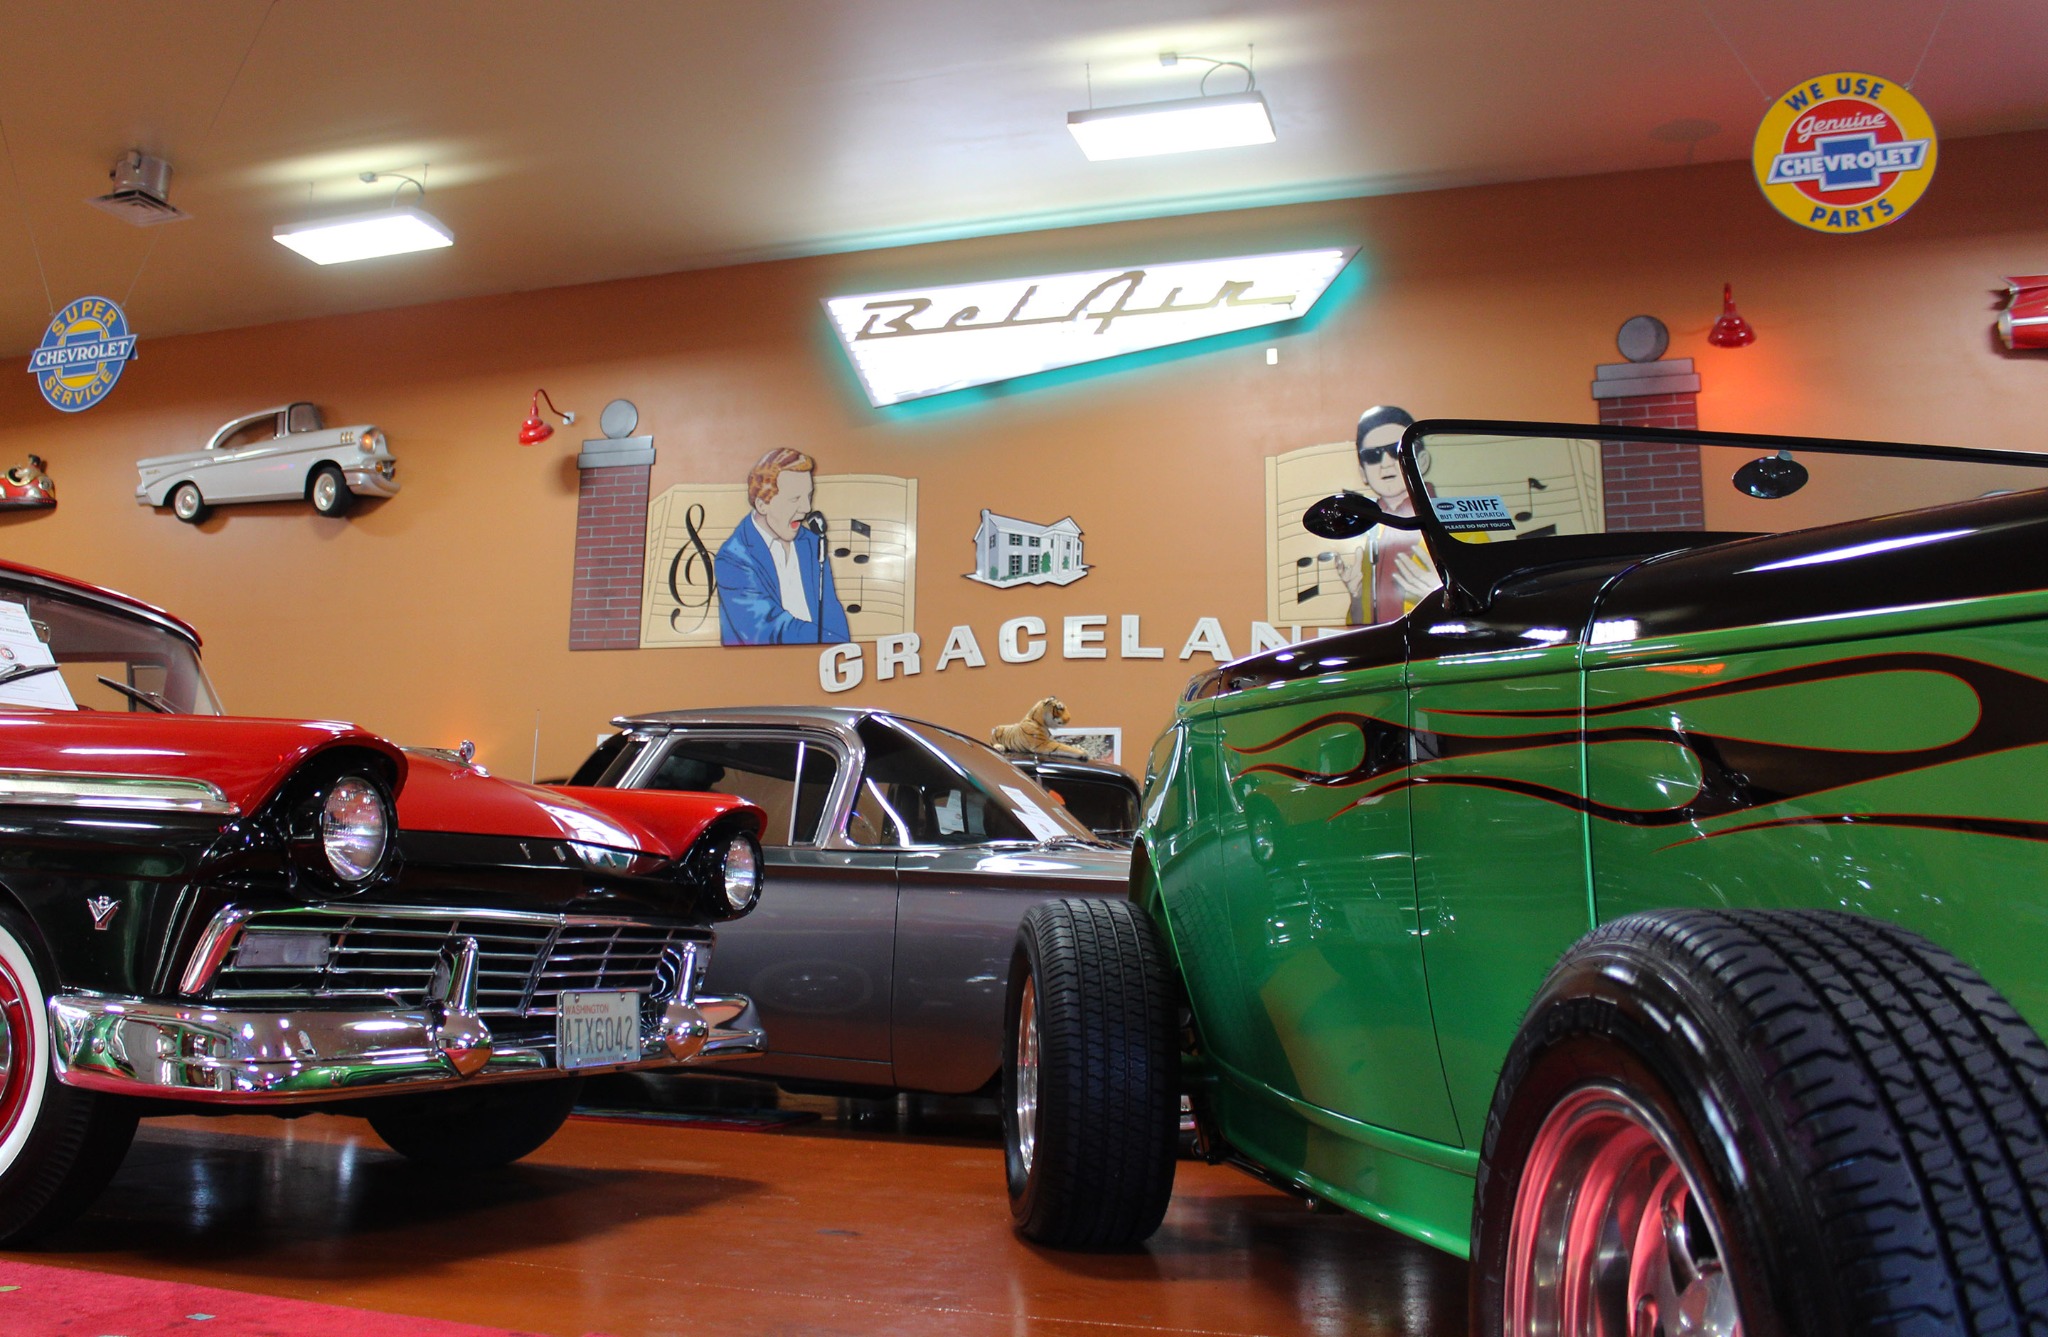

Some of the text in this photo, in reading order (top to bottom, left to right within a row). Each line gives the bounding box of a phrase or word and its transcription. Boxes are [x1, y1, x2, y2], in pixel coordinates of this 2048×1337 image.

[1784, 77, 1885, 111] WE USE
[1796, 111, 1887, 144] Genuine
[1779, 147, 1914, 177] CHEVROLET
[1810, 198, 1895, 228] PARTS
[52, 300, 118, 336] SUPER
[36, 340, 129, 367] CHEVROLET
[44, 369, 114, 406] SERVICE
[1456, 499, 1499, 512] SNIFF
[818, 614, 1350, 693] GRACELAN
[565, 1003, 609, 1014] WASHINGTON
[564, 1015, 634, 1055] ATX6042
